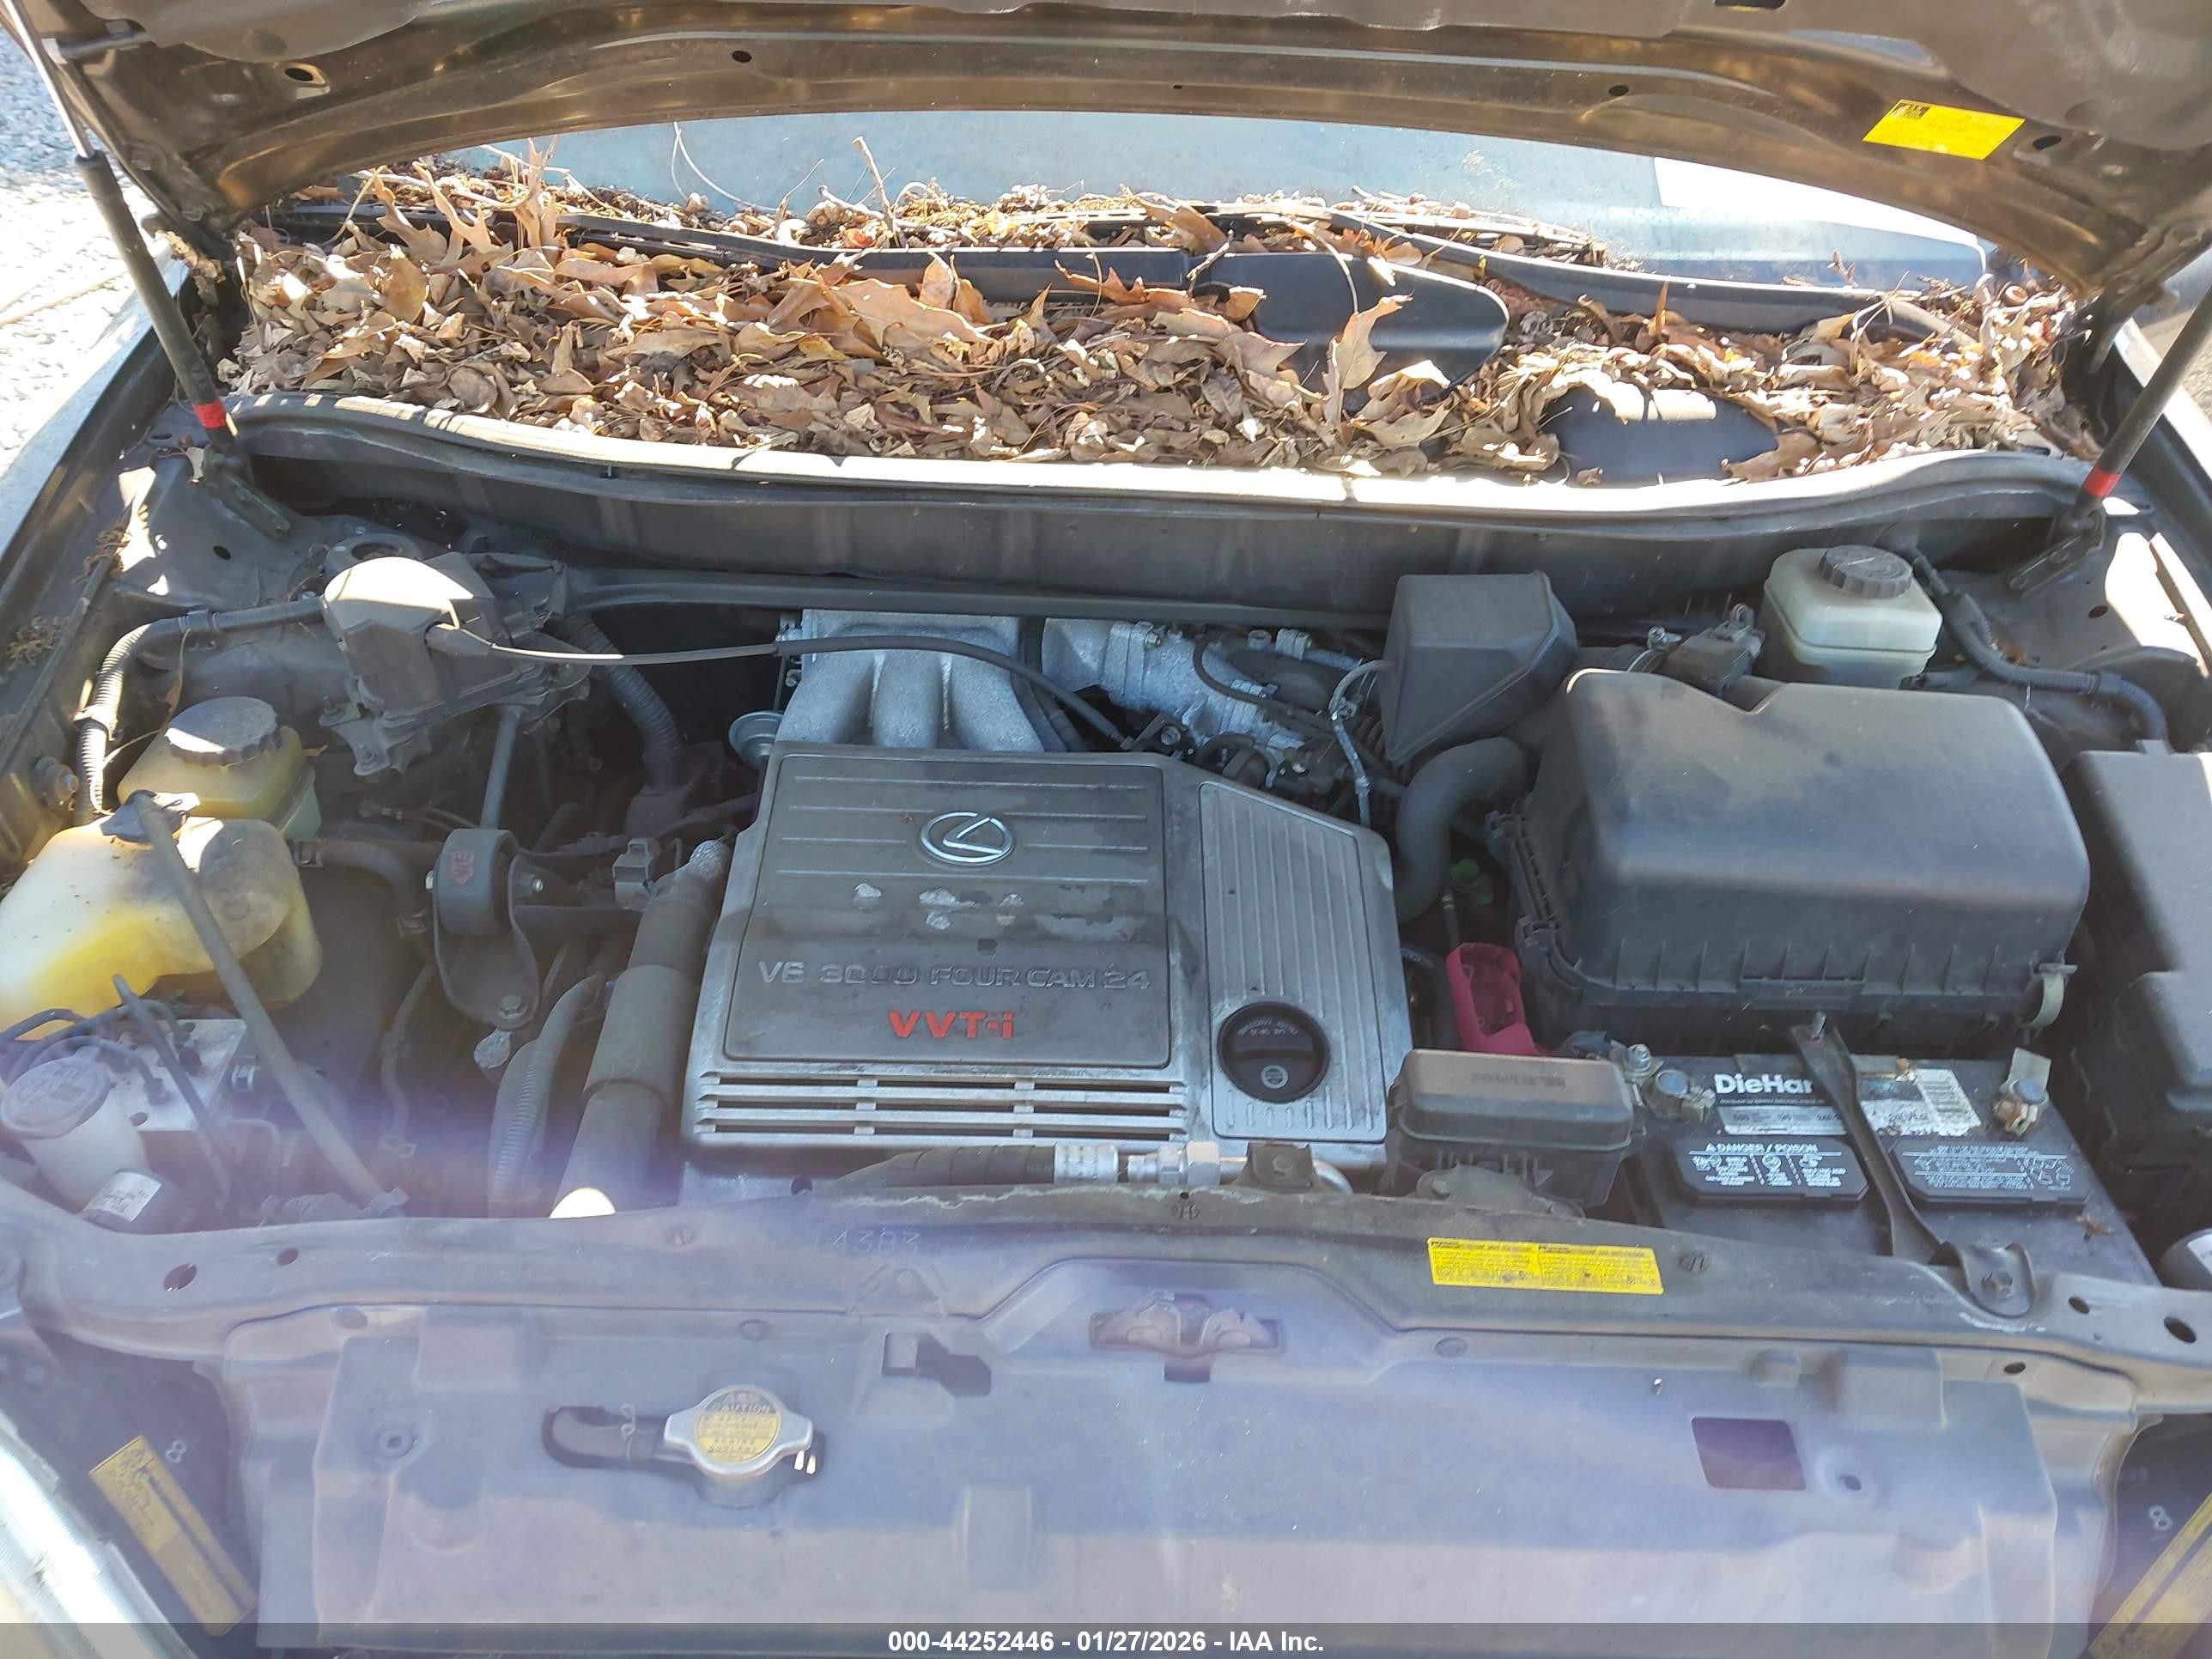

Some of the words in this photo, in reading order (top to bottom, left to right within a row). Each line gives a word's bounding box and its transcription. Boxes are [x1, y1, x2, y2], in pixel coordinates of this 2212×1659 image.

[759, 961, 805, 984] V6
[819, 963, 919, 986] 3000
[929, 964, 1020, 988] FOUR
[1026, 967, 1096, 988] CAM
[1104, 969, 1151, 990] 24
[1713, 1073, 1814, 1095] DieHar
